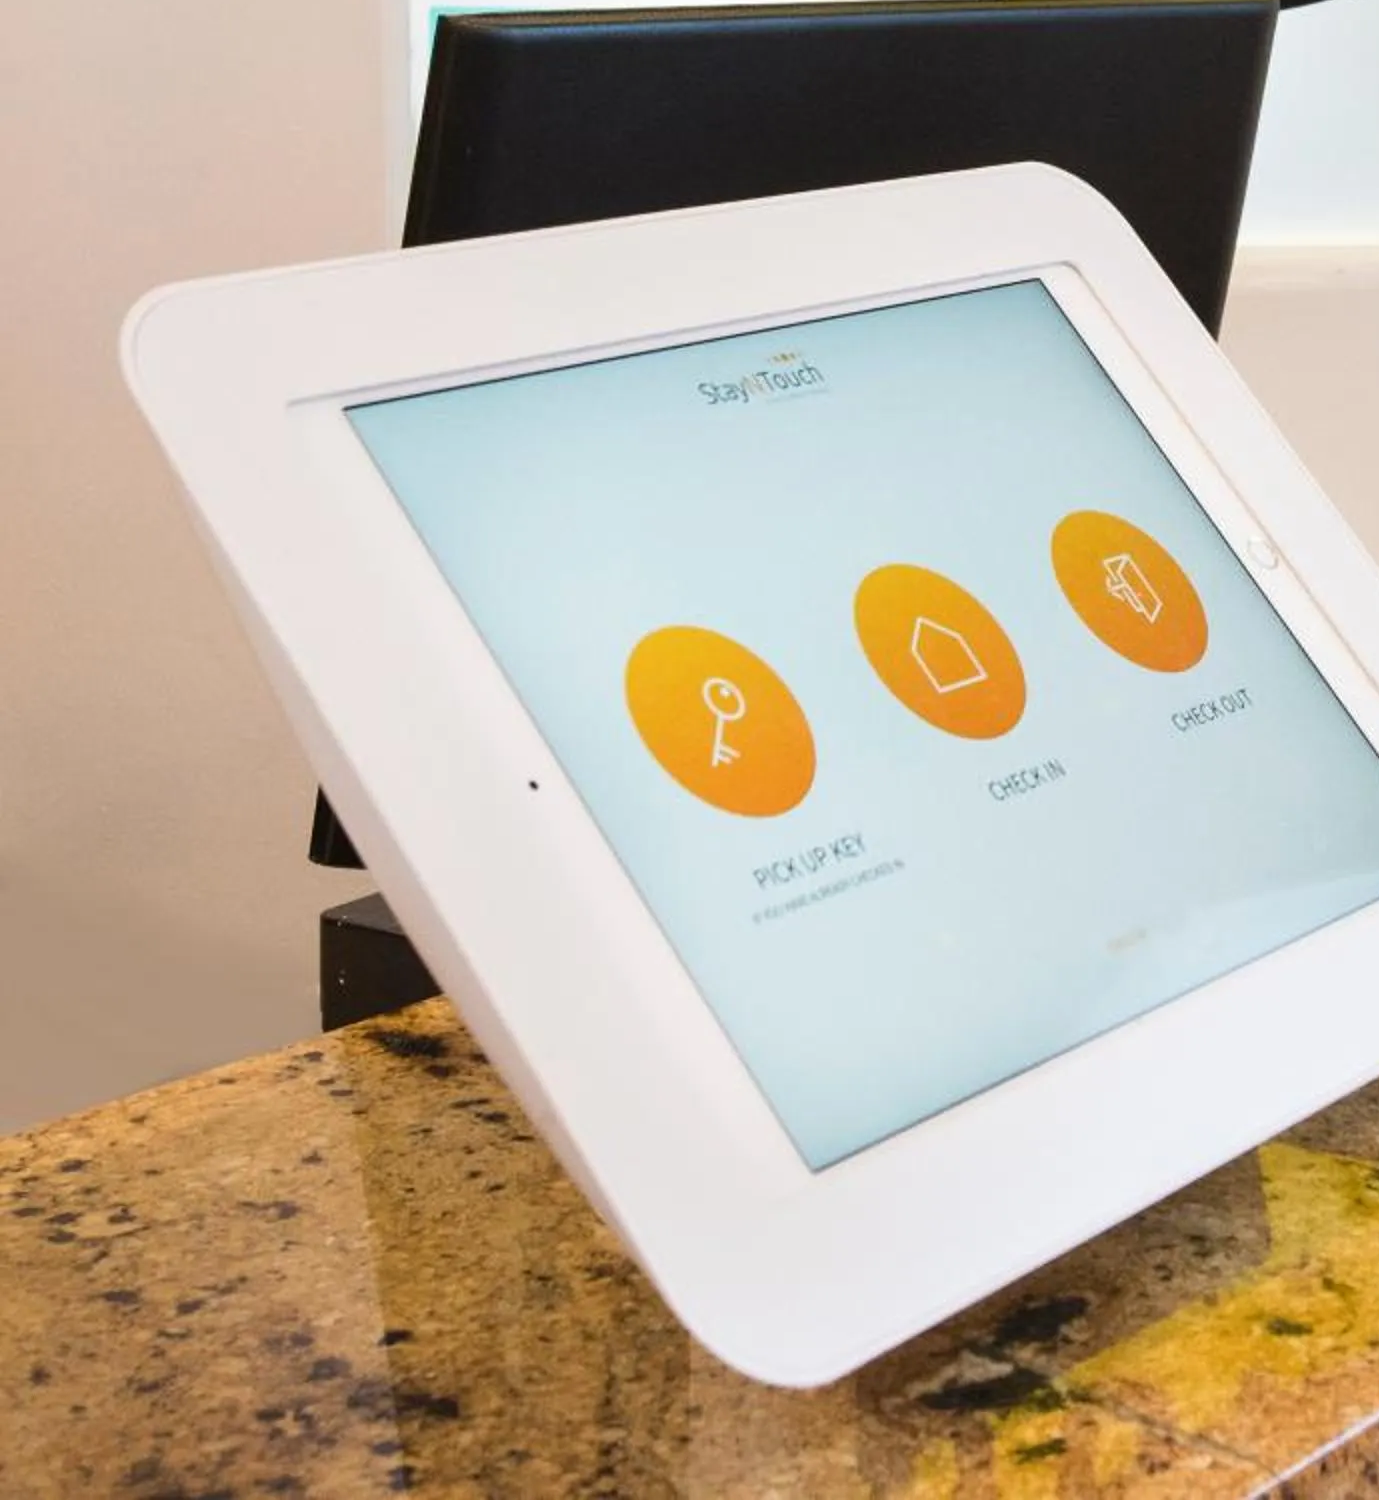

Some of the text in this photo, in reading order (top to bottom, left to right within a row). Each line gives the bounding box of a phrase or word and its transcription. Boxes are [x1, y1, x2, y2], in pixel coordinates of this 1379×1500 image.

[1171, 688, 1253, 732] CHECK OUT
[988, 759, 1067, 801] CHECK IN
[753, 833, 866, 889] PICK UP KEY
